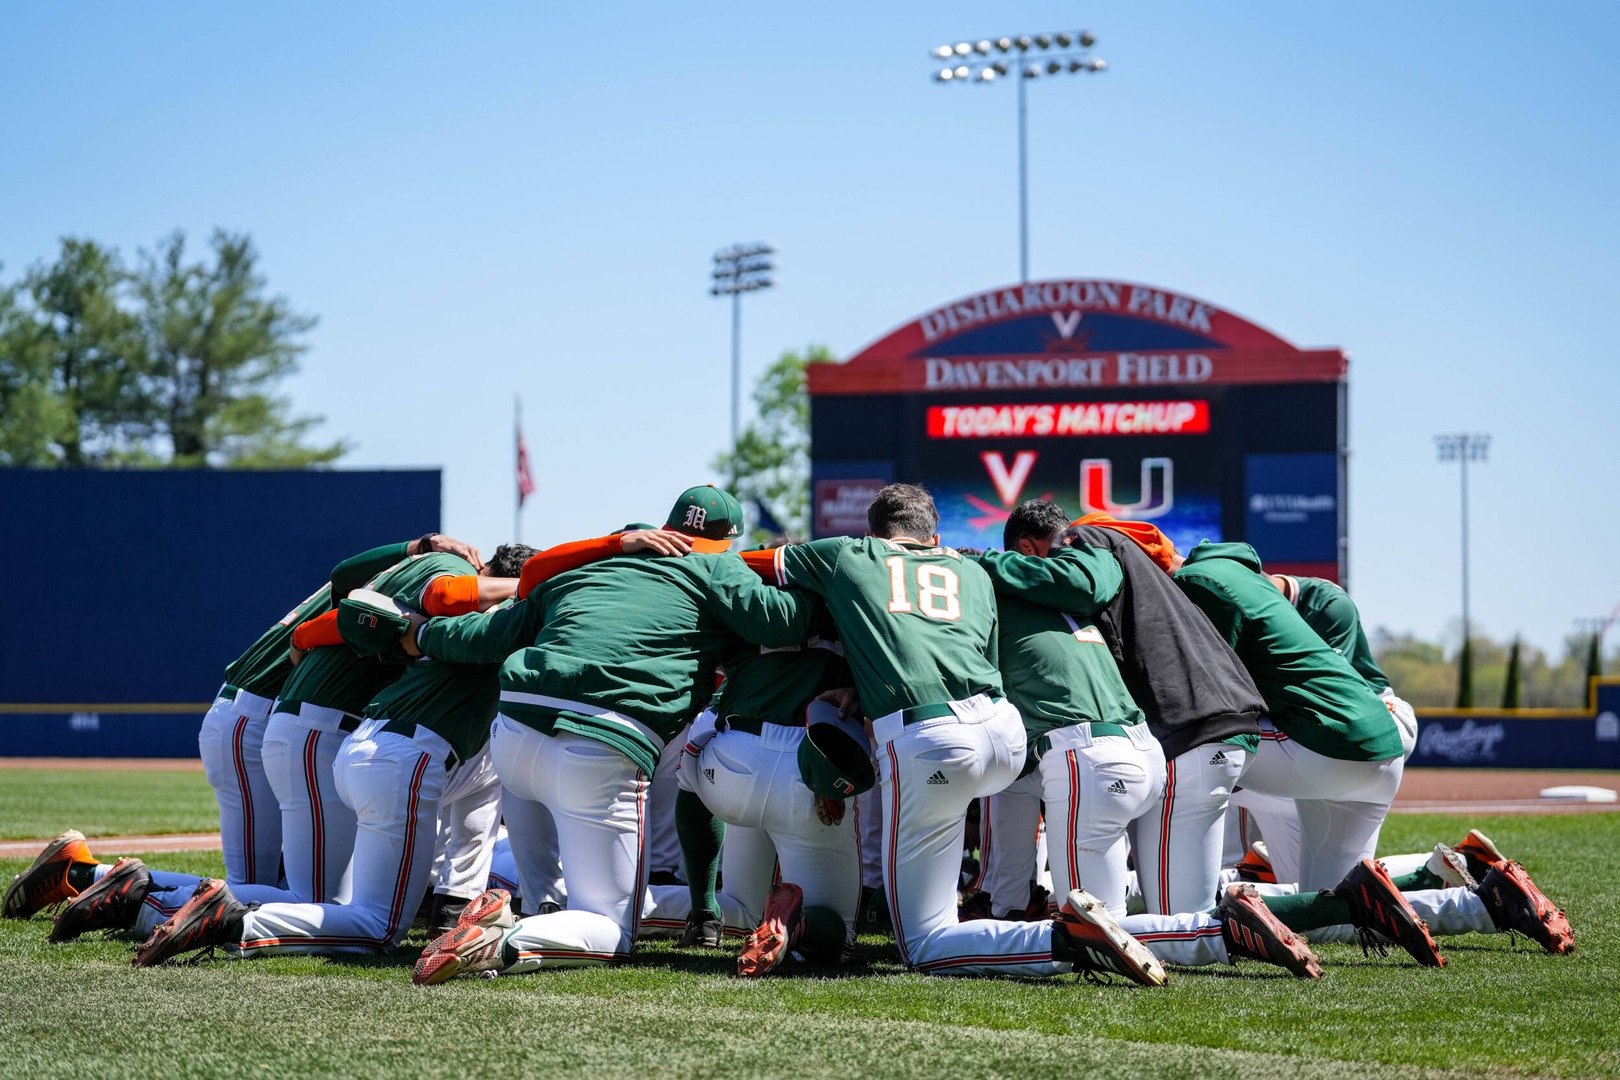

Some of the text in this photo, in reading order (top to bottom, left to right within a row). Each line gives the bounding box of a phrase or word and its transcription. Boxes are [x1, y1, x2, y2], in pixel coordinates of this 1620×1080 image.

[920, 281, 1217, 340] DISHAROON PARK
[925, 352, 1213, 389] DAVENPORT FIELD
[942, 402, 1196, 437] TODAY'S MATCHUP
[1080, 457, 1174, 515] U
[886, 556, 961, 621] 18
